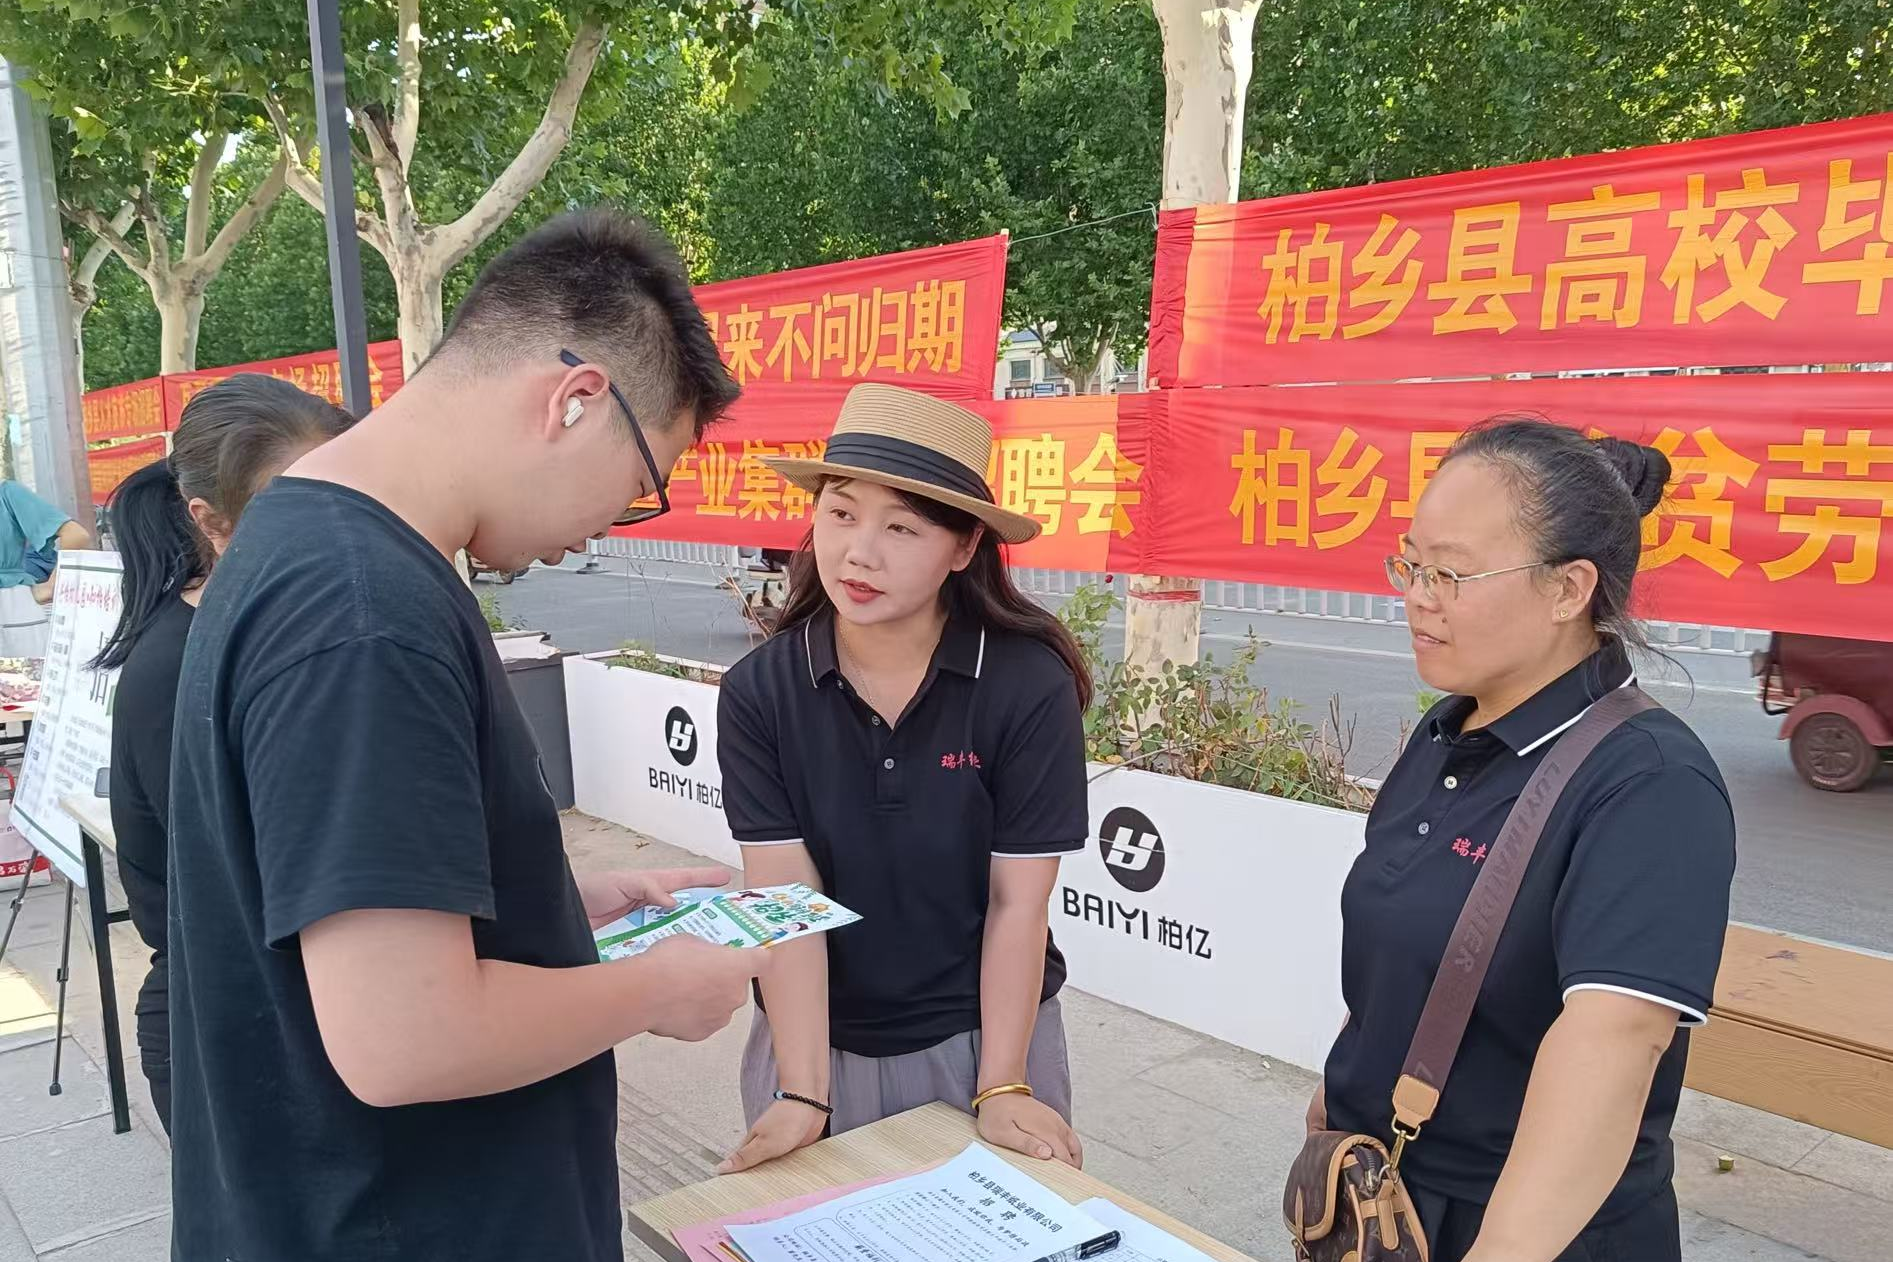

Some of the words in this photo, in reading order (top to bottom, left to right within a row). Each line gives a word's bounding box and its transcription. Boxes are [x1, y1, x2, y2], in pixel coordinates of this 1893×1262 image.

[1257, 151, 1893, 345] 柏乡县高校毕
[703, 279, 967, 388] 来不问归期
[649, 767, 692, 800] BAIYI
[696, 781, 722, 809] 柏亿
[1063, 886, 1148, 940] BAIYI
[1158, 916, 1212, 960] 柏亿
[968, 1170, 1063, 1233] 柏乡县瑞丰纸业有限公司
